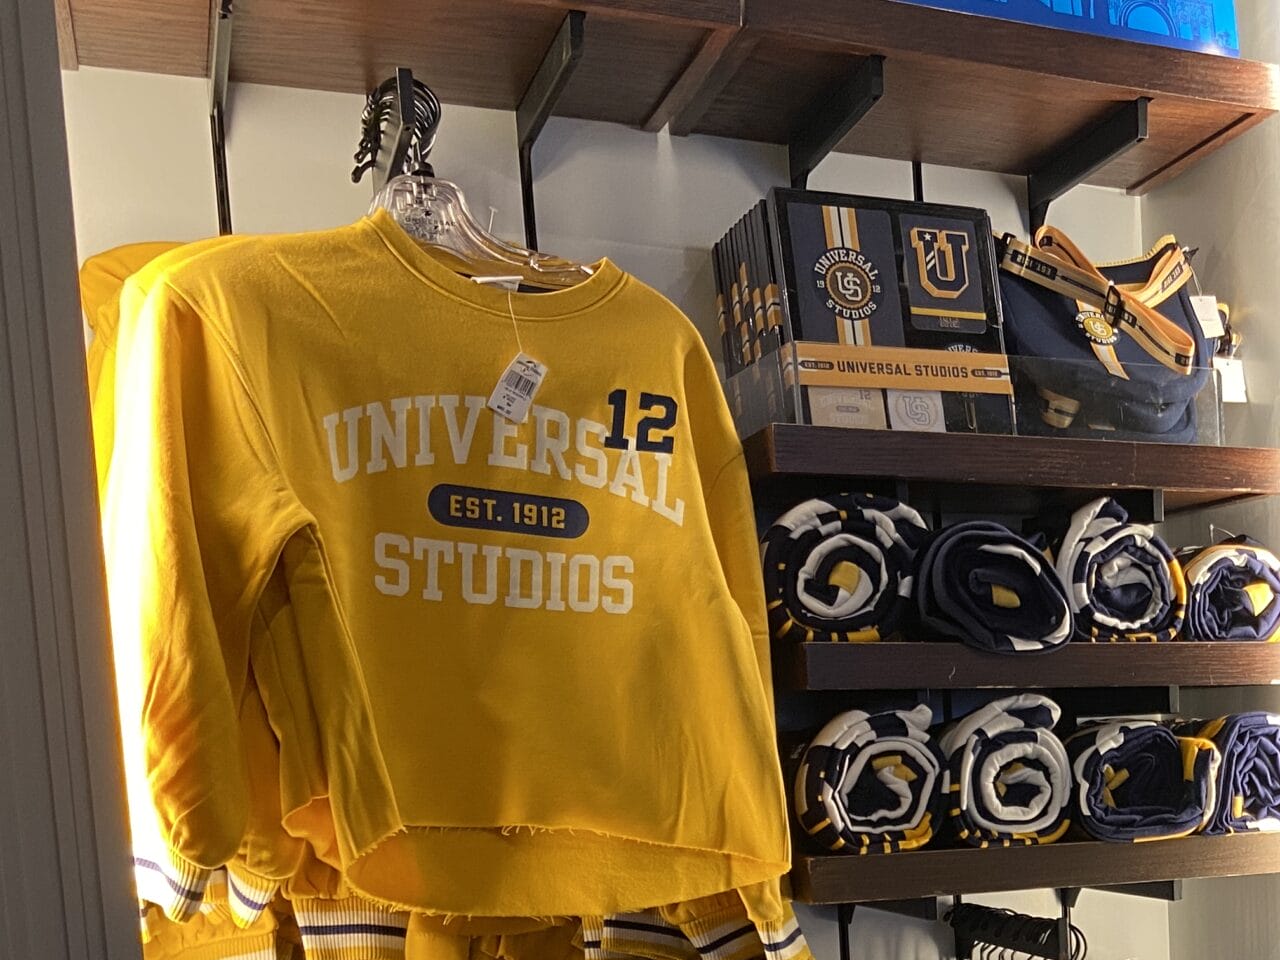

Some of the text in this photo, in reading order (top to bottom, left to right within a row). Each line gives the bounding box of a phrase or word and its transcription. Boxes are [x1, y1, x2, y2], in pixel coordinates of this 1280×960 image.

[813, 249, 880, 281] UNIVERSAL
[825, 299, 878, 320] STUDIOS
[837, 360, 911, 376] UNIVERSAL
[914, 365, 969, 379] STUDIOS
[604, 388, 679, 454] 12
[323, 395, 685, 527] UNIVERSAL
[449, 495, 566, 529] EST. 1912
[374, 532, 634, 615] STUDIOS
